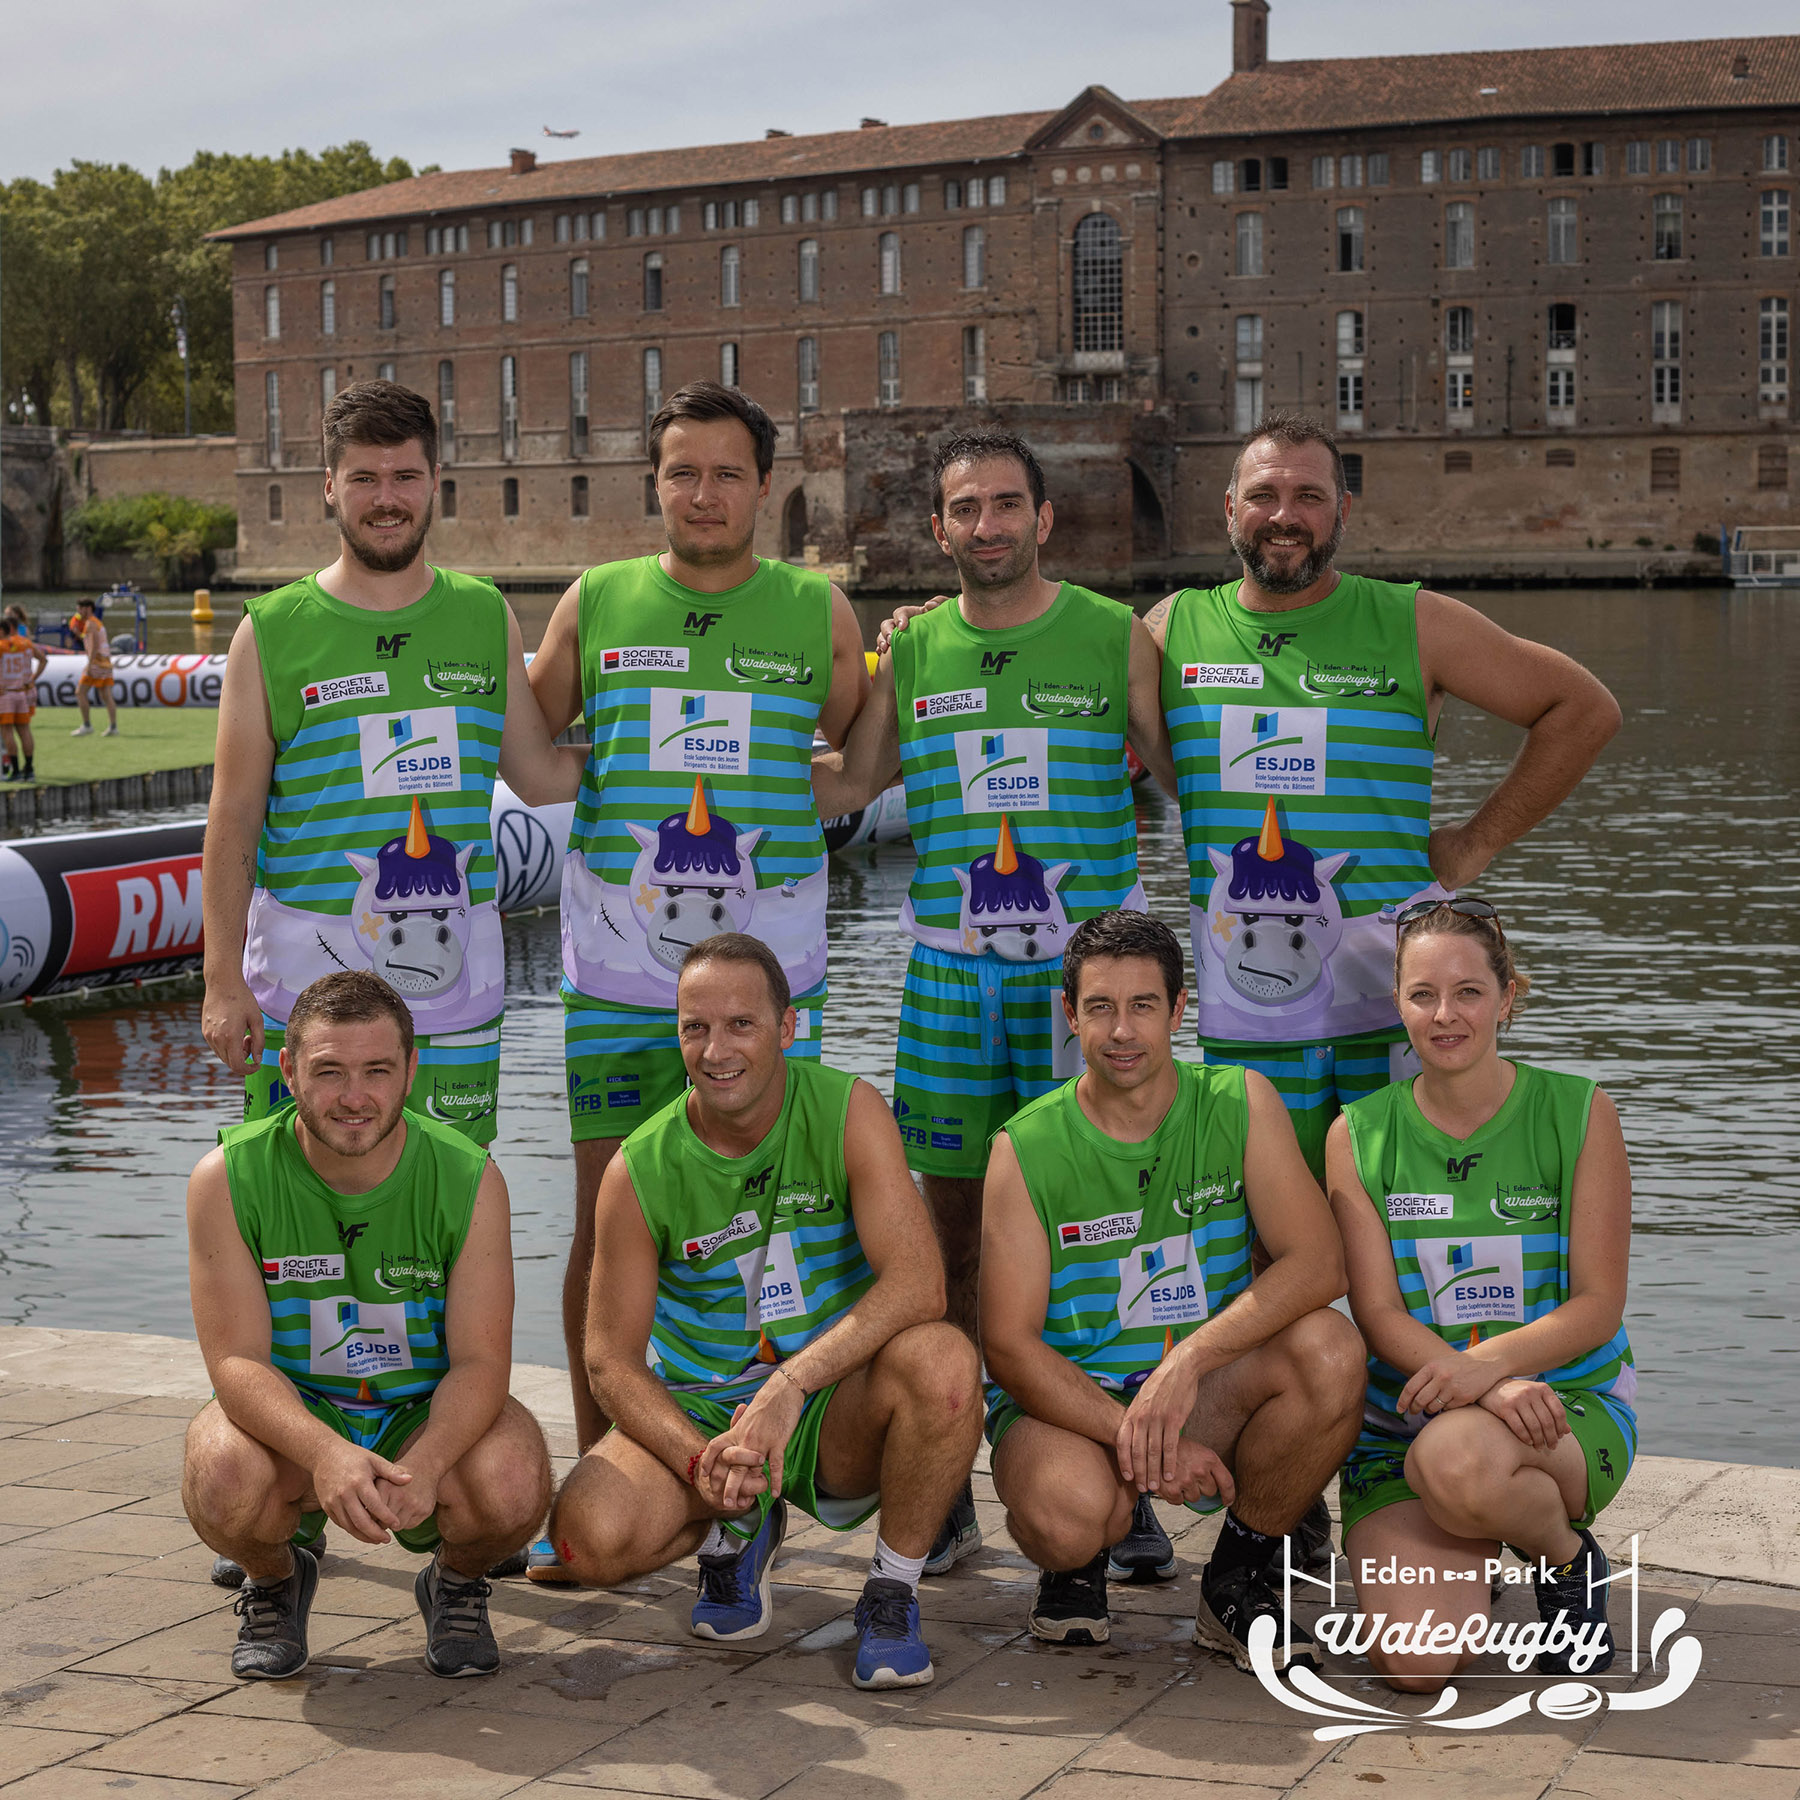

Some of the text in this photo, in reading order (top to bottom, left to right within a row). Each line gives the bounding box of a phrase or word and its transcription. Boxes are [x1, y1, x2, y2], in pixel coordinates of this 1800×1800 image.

[683, 612, 723, 636] MF
[375, 632, 412, 659] MF
[1257, 633, 1298, 657] MF
[622, 649, 674, 659] SOCIETE
[748, 648, 789, 659] Eden Park
[622, 658, 685, 668] GENERALE
[739, 657, 798, 677] WateRugby
[980, 651, 1018, 675] MF
[1351, 664, 1368, 673] Park
[1199, 666, 1249, 676] SOCIETE
[320, 676, 373, 693] SOCIETE
[436, 671, 487, 687] WateRugby
[1199, 675, 1260, 685] GENERALE
[1313, 673, 1379, 687] WateRugby
[322, 684, 386, 701] GENERALE
[1044, 682, 1085, 692] Eden Park
[929, 692, 973, 706] SOCIETE
[1034, 693, 1094, 708] WateRugby
[929, 700, 983, 715] GENERALE
[684, 737, 740, 753] ESJDB
[396, 757, 452, 773] ESJDB
[1255, 757, 1316, 772] ESJDB
[987, 776, 1040, 791] ESJDB
[1283, 782, 1290, 790] du
[574, 1094, 602, 1112] FFB
[1447, 1153, 1483, 1181] MF
[1386, 1197, 1436, 1207] SOCIETE
[1387, 1206, 1449, 1217] GENERALE
[1083, 1216, 1134, 1233] SOCIETE
[1084, 1225, 1139, 1242] GENERAL
[283, 1258, 328, 1270] SOCIETE
[282, 1267, 340, 1279] GENERALE
[1150, 1284, 1196, 1303] ESJDB
[1455, 1286, 1515, 1301] ESJDB
[346, 1342, 400, 1359] ESJDB
